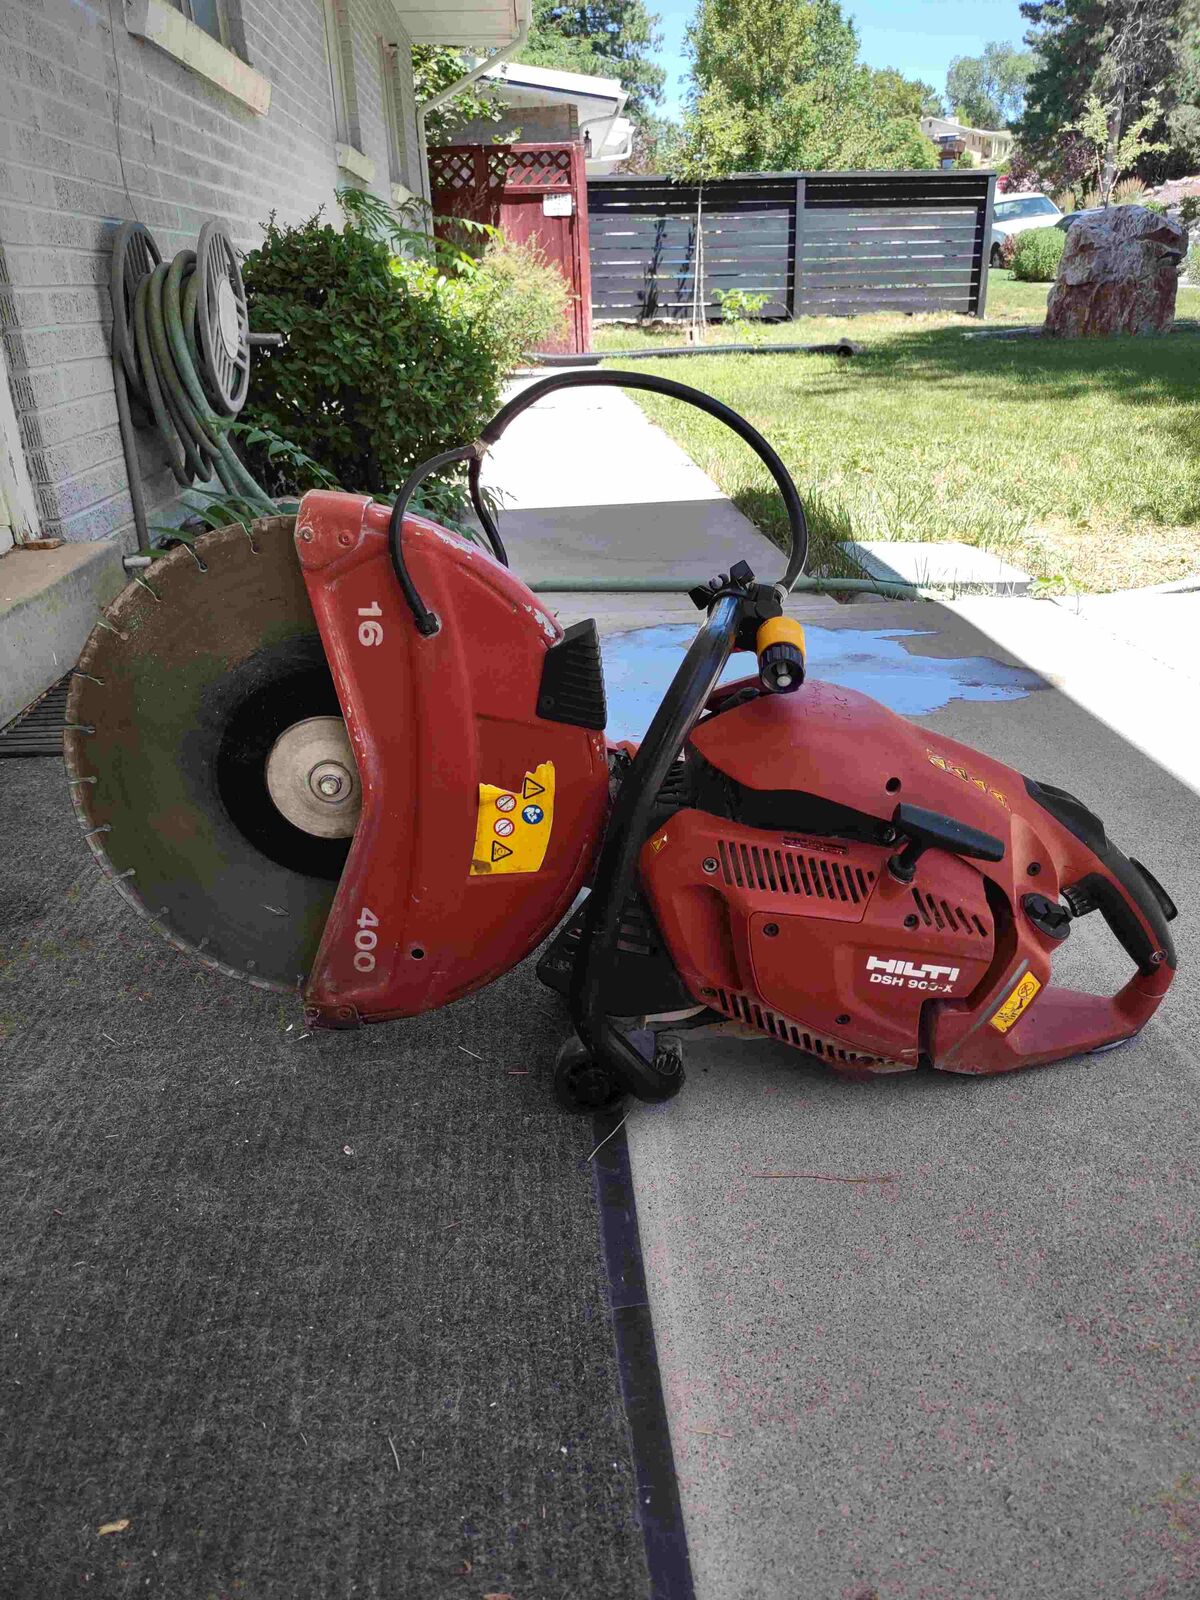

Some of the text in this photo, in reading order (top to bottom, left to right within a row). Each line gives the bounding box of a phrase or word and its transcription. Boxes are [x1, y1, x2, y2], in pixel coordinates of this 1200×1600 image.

[358, 601, 384, 647] 16
[353, 907, 380, 973] 400
[866, 956, 960, 982] HILTI
[869, 973, 904, 987] DSH
